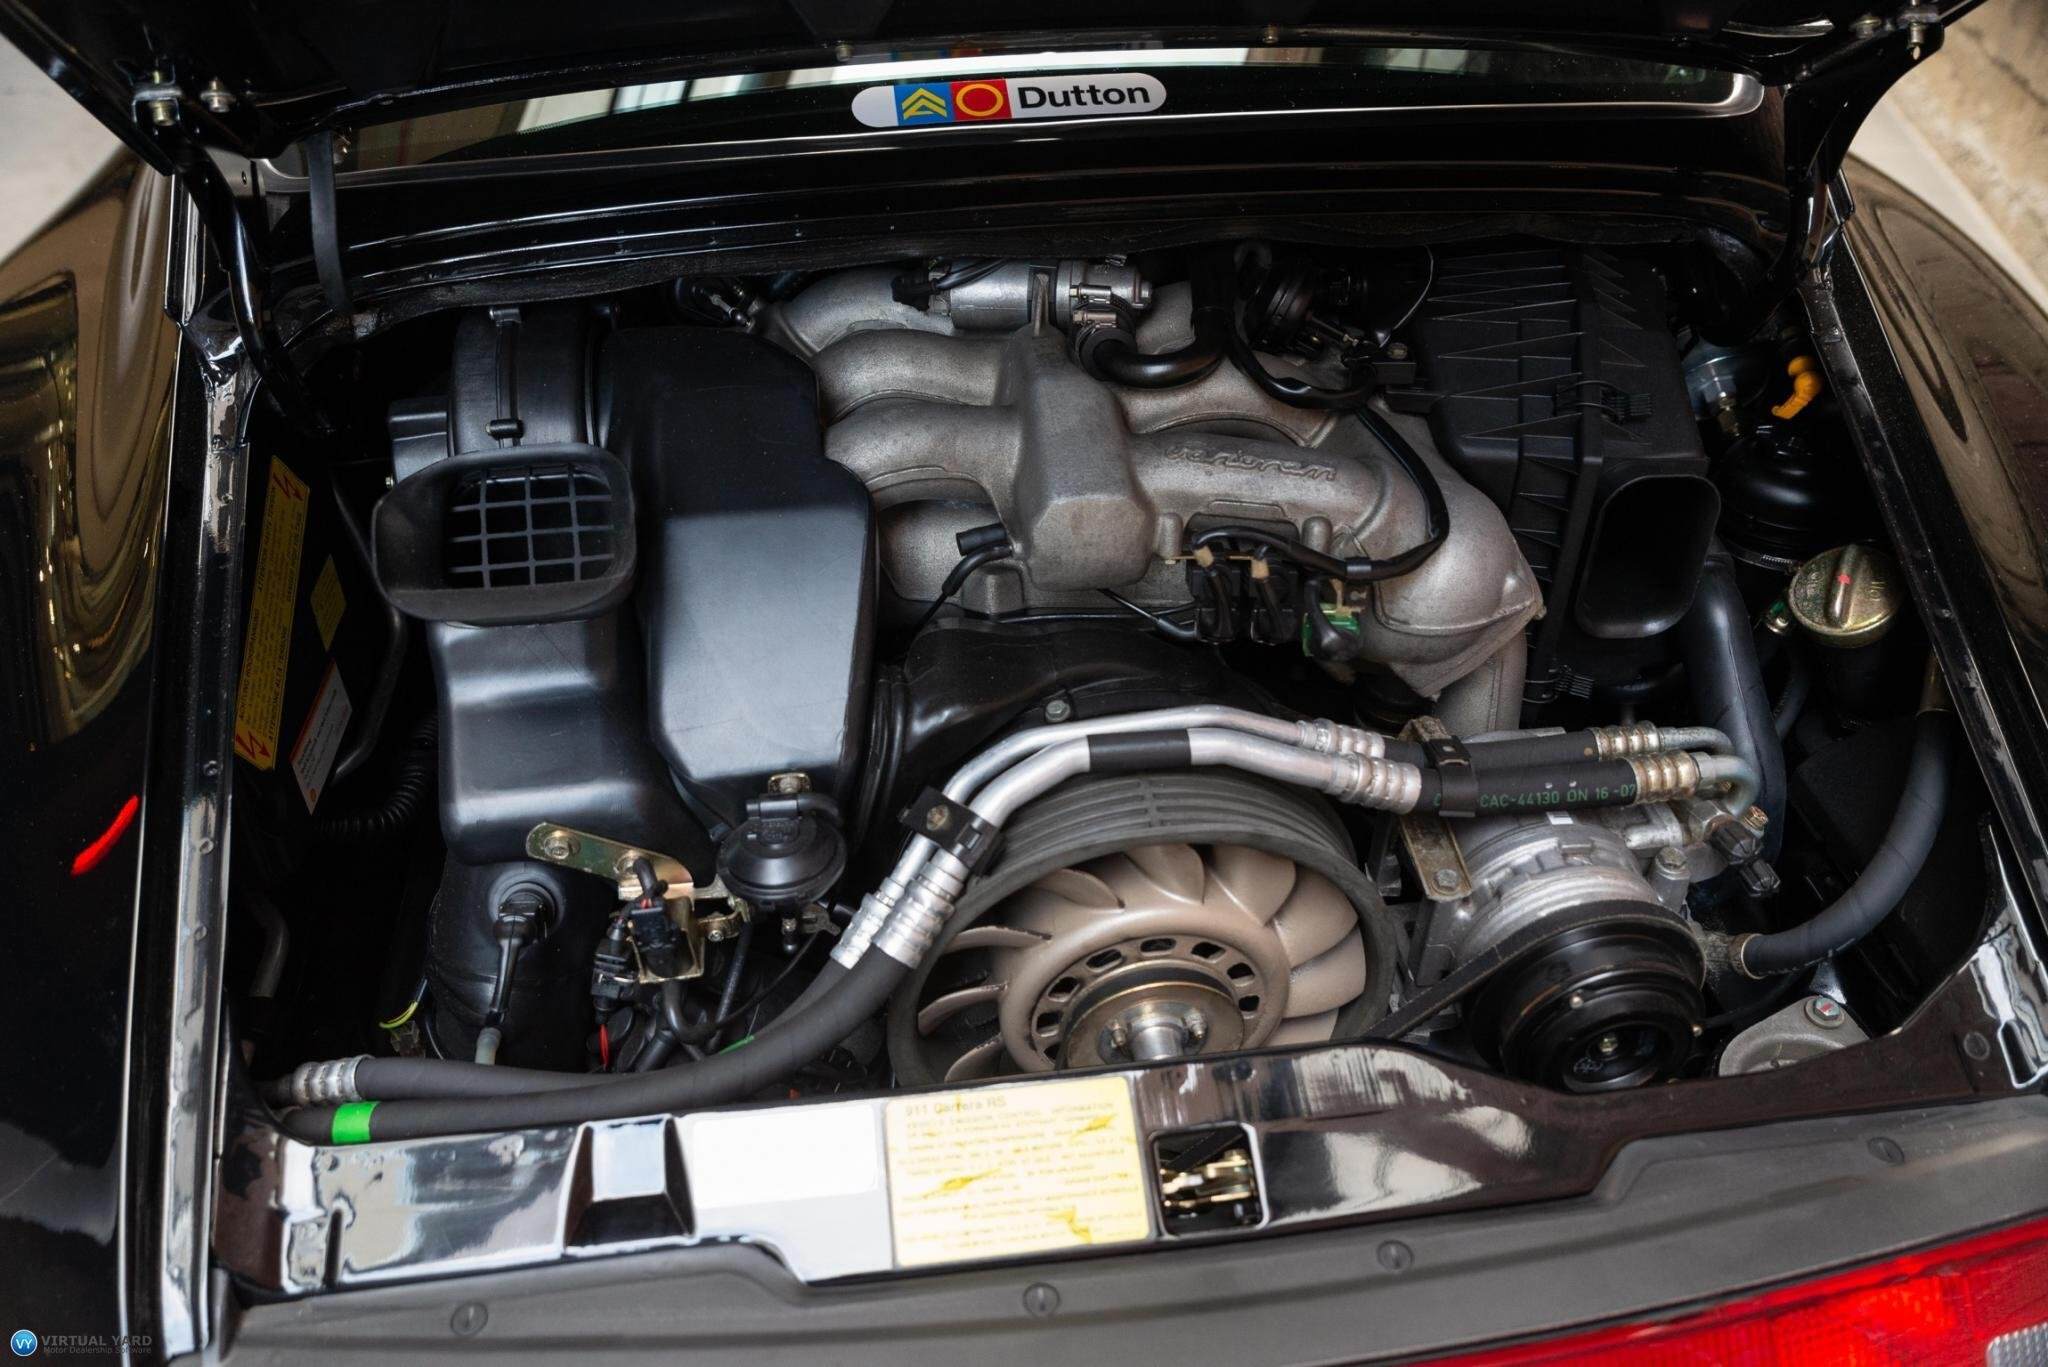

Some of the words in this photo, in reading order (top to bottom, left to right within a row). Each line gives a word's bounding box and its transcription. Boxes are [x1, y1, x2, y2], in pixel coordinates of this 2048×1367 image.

[1018, 85, 1150, 108] Dutton
[1596, 786, 1609, 799] 16
[987, 1094, 1007, 1109] RS
